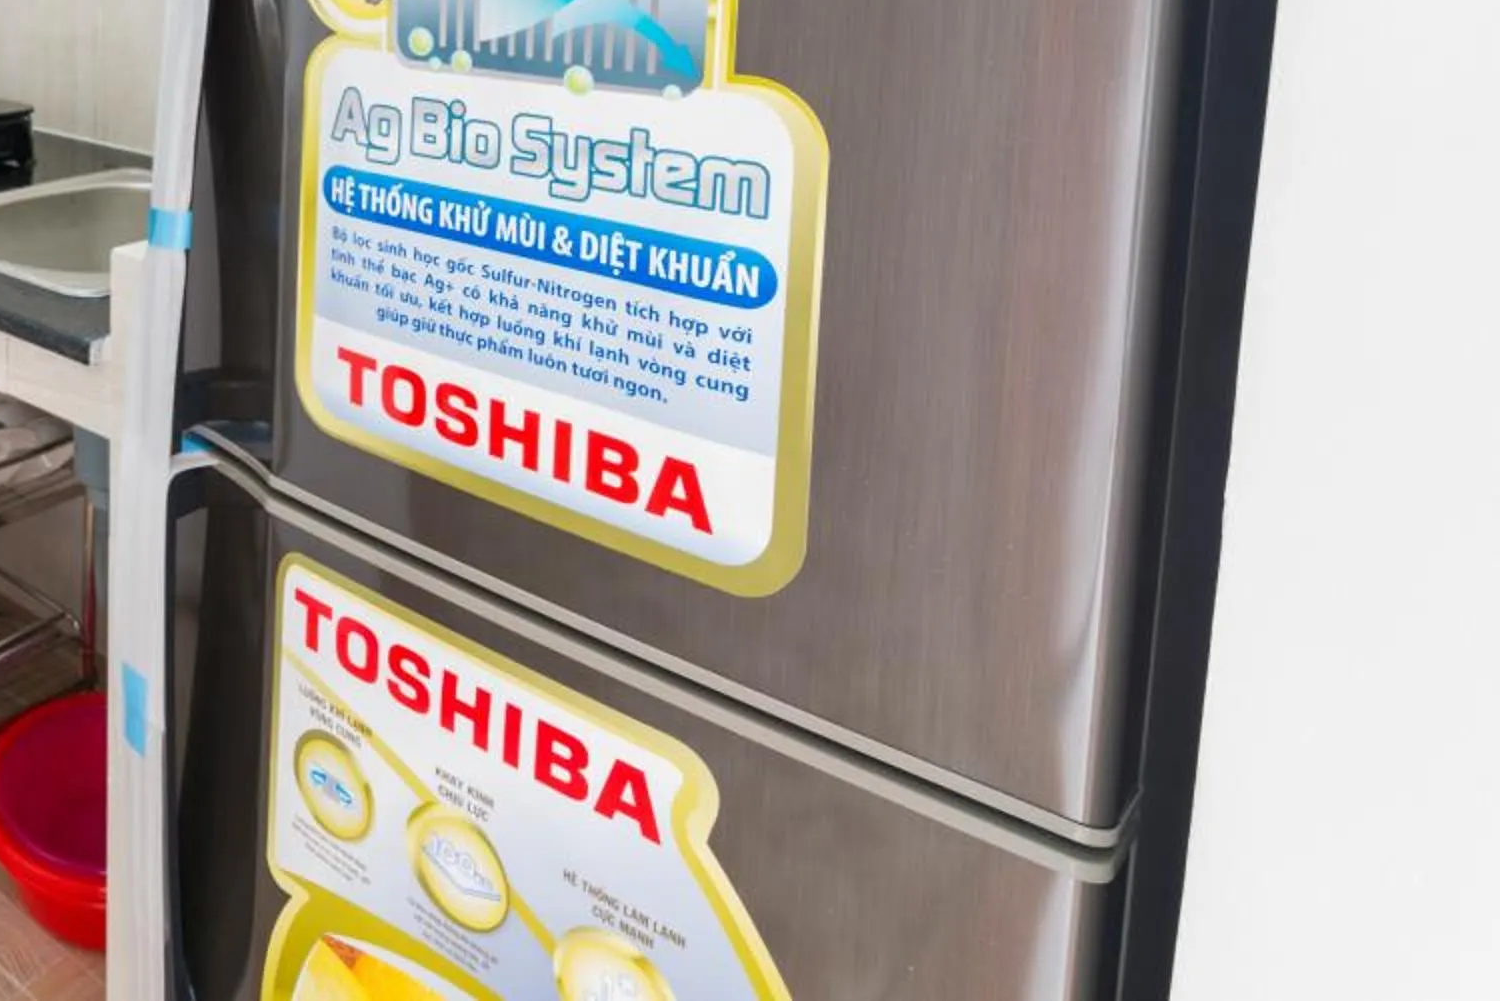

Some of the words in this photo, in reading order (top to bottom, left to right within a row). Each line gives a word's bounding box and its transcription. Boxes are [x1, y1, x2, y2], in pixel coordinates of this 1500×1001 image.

[331, 86, 401, 165] Ag
[410, 96, 501, 168] Bio
[509, 112, 771, 220] System
[331, 175, 356, 214] HỆ
[358, 183, 434, 226] THỐNG
[438, 200, 492, 237] KHỬ
[495, 212, 547, 251] MÙI
[551, 224, 573, 258] &
[579, 229, 643, 276] DIỆT
[648, 245, 760, 298] KHUẨN
[376, 239, 408, 259] sinh
[413, 246, 440, 270] học
[625, 298, 660, 324] tích
[668, 309, 709, 338] hợp
[424, 273, 455, 294] Ag+
[672, 340, 697, 360] và
[706, 347, 752, 374] diệt
[458, 305, 491, 330] hợp
[588, 339, 630, 367] lạnh
[695, 374, 751, 403] cung
[337, 345, 714, 537] TOSHIBA
[613, 374, 669, 405] ngon.
[294, 586, 662, 847] TOSHIBA
